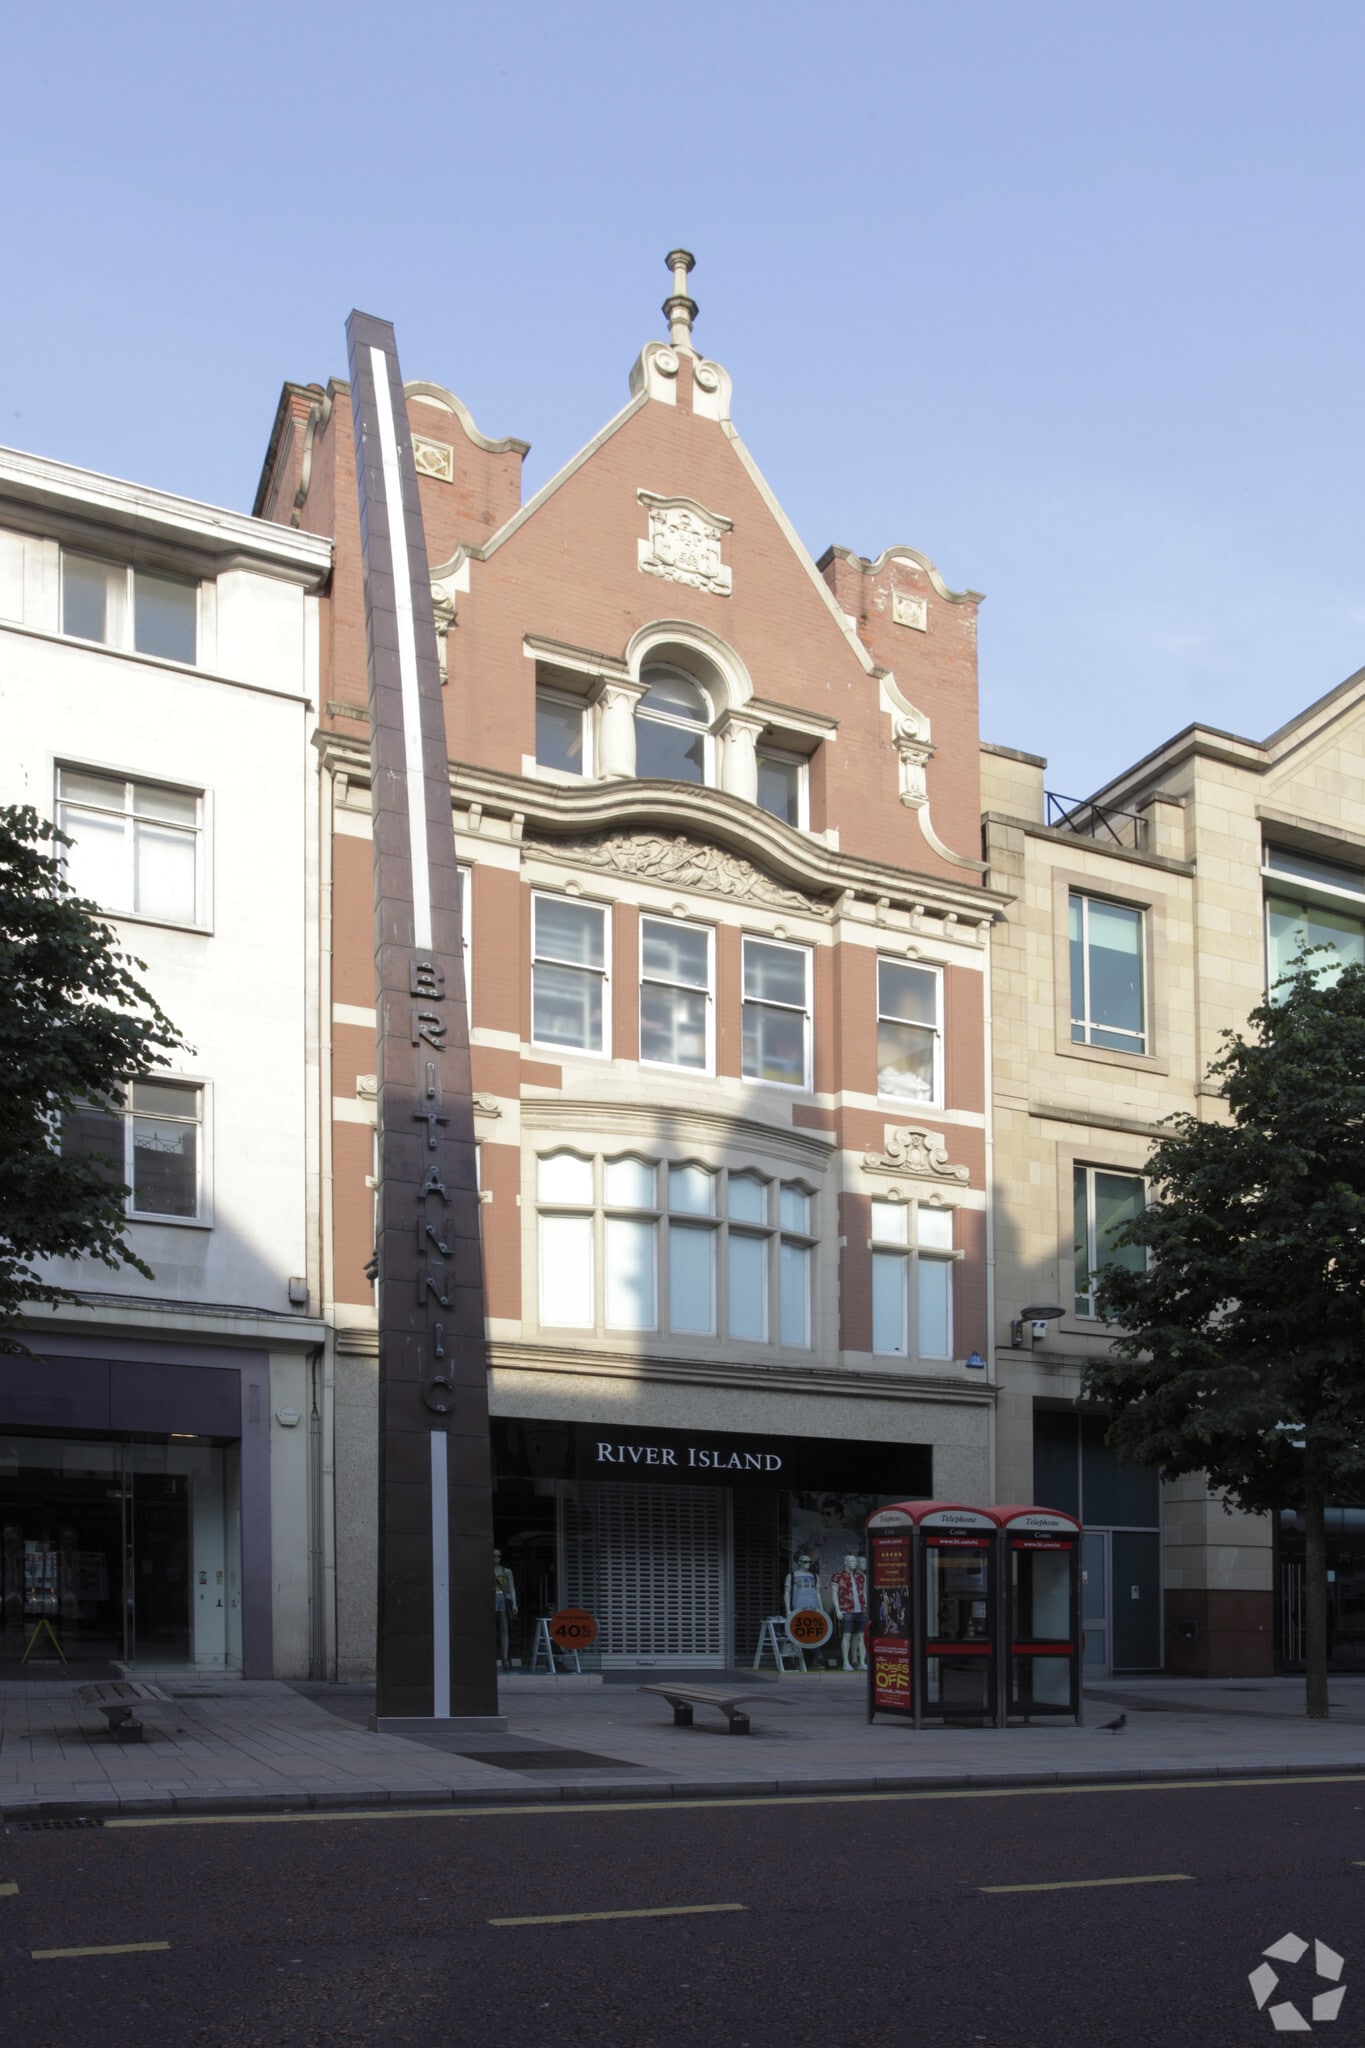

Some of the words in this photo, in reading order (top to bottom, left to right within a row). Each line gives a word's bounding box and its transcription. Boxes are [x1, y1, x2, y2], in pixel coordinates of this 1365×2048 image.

[408, 959, 457, 1414] BRITANNIC
[596, 1442, 679, 1466] RIVER
[687, 1448, 783, 1471] ISLAND
[940, 1514, 977, 1524] Telephone
[1025, 1518, 1060, 1527] Telephone
[949, 1528, 967, 1536] Coins
[1034, 1531, 1051, 1539] Coins
[795, 1617, 824, 1627] 30%
[555, 1624, 592, 1638] 40%
[795, 1627, 824, 1637] OFF
[876, 1661, 910, 1673] NOISES
[876, 1672, 910, 1688] OFF
